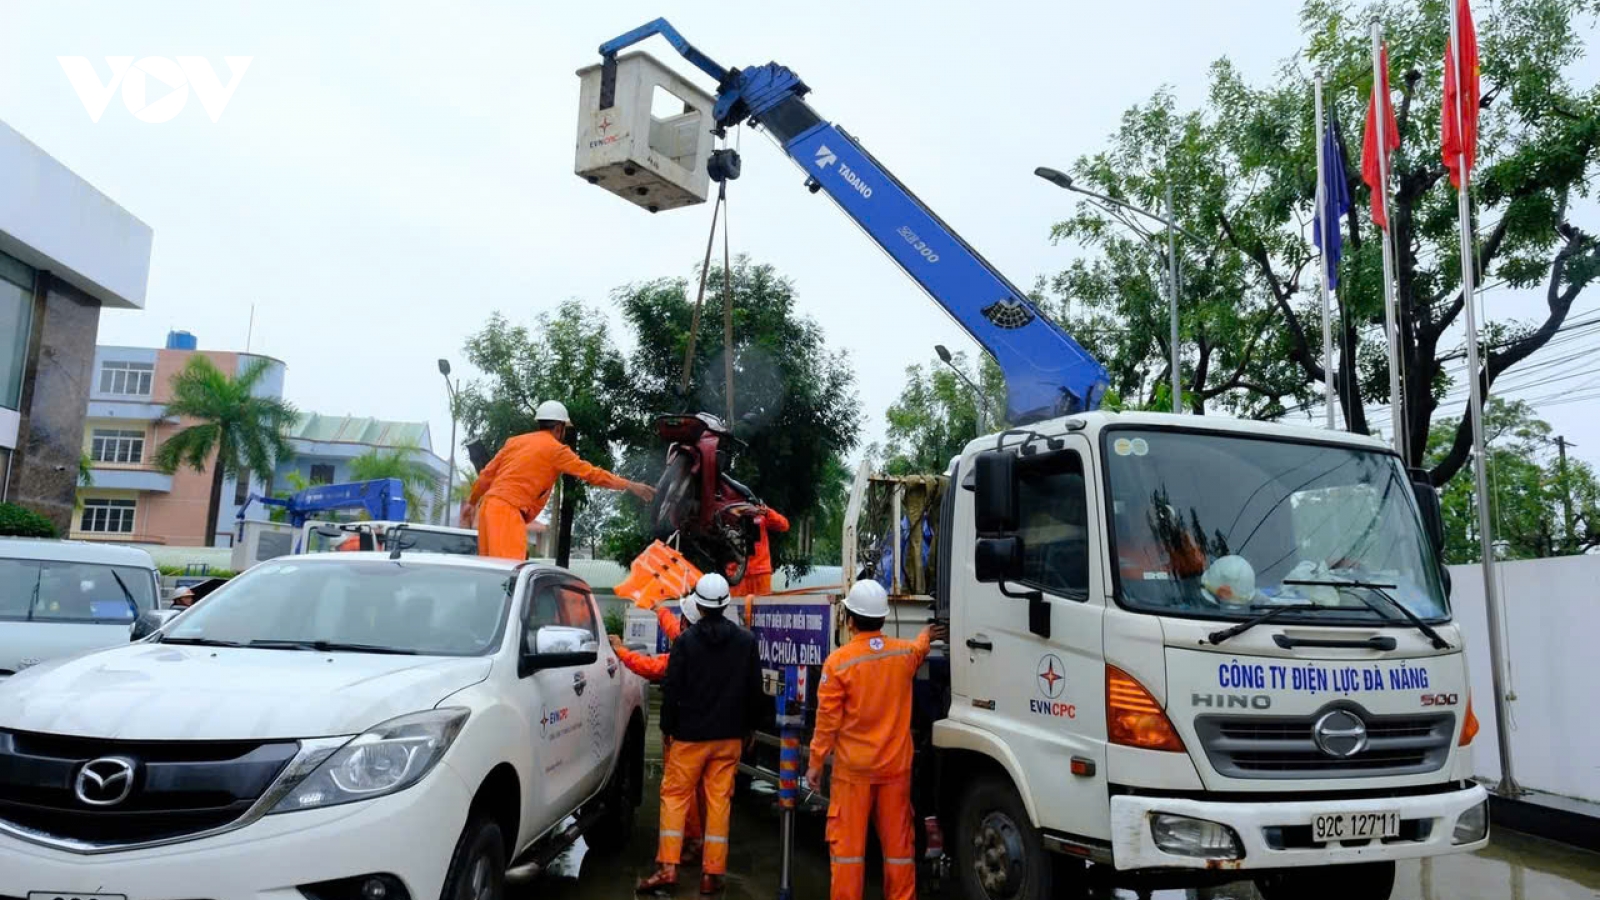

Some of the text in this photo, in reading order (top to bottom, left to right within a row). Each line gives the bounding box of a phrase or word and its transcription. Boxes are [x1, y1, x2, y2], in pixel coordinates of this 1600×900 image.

[838, 163, 873, 199] TADANO
[758, 632, 771, 661] ỬA
[771, 636, 797, 665] CHỮA
[1219, 659, 1265, 689] CÔNG
[1269, 666, 1286, 690] TY
[1292, 662, 1328, 695] ĐIỆN
[1333, 666, 1360, 696] LỰC
[1363, 664, 1385, 691] ĐÀ
[1030, 699, 1076, 719] EVNCPC
[1191, 693, 1271, 710] HINO
[1420, 693, 1458, 706] 500
[1316, 815, 1343, 838] 92C
